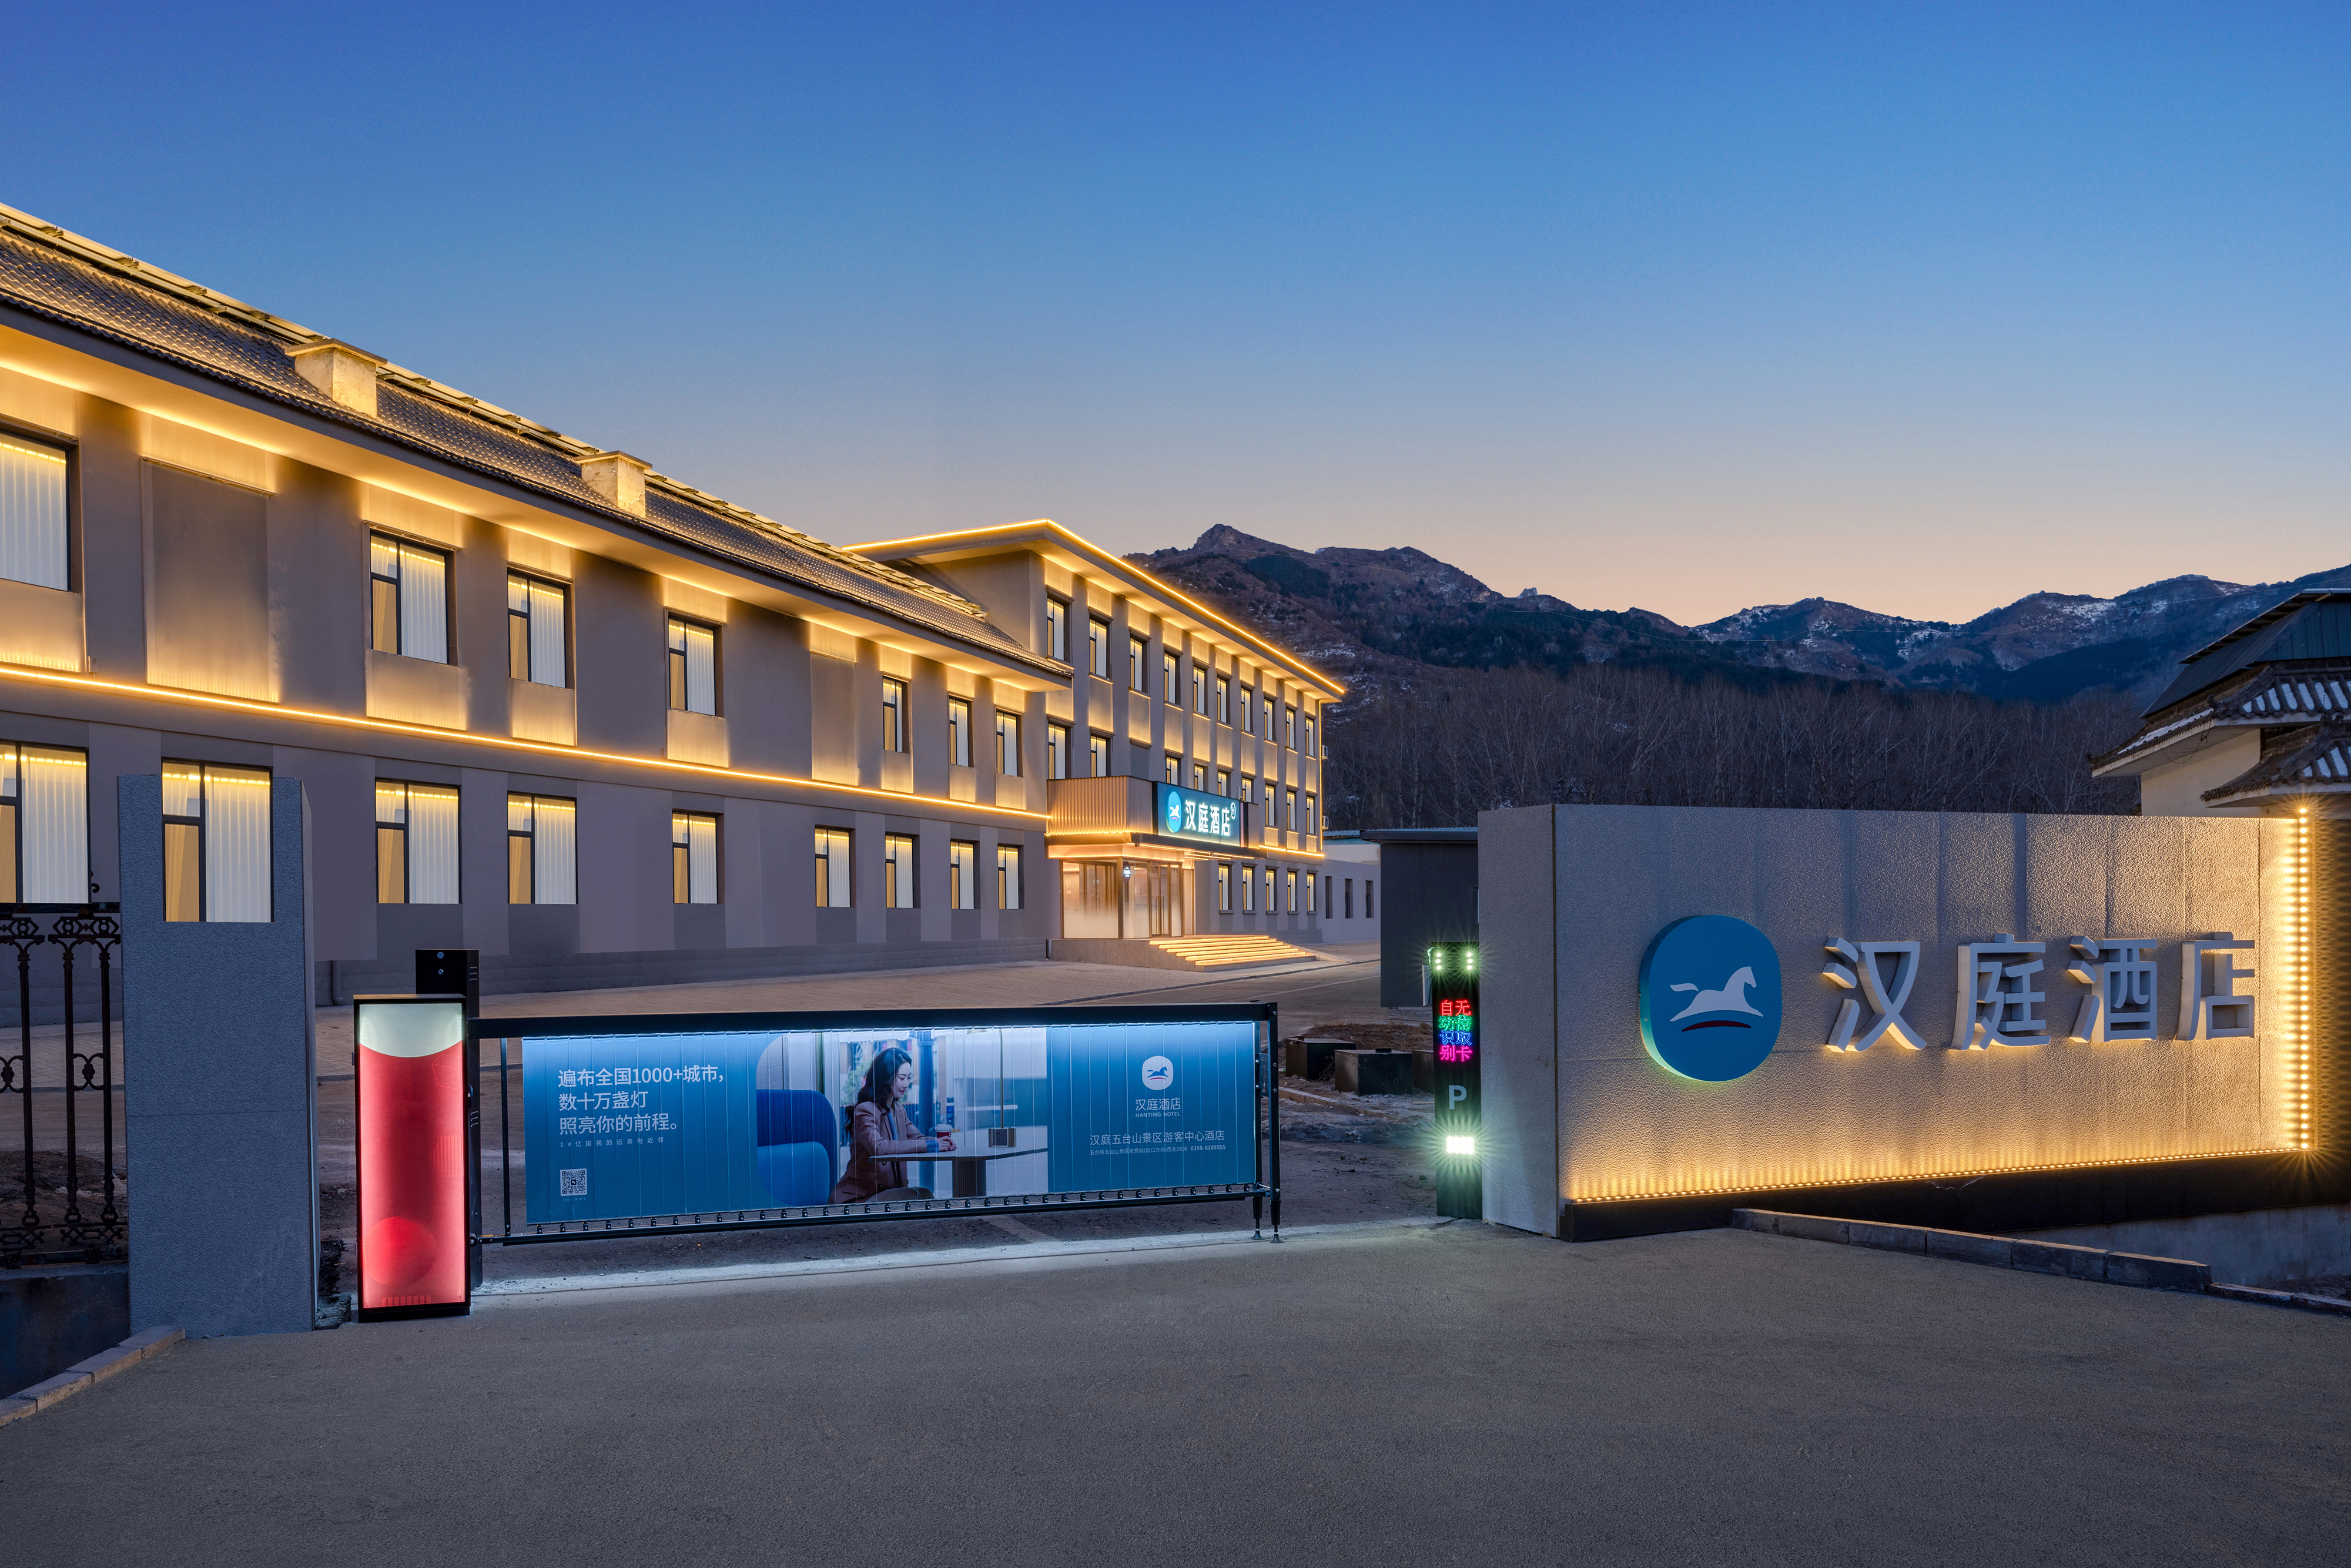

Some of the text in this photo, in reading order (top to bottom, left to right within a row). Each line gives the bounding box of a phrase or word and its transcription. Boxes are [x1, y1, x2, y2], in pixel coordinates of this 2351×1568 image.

[1184, 799, 1230, 837] 汉庭酒店
[1821, 931, 2256, 1053] 汉庭酒店
[558, 1064, 724, 1088] 遍布全国1000+城市，
[558, 1090, 649, 1112] 数十万盏灯
[1135, 1097, 1181, 1111] 汉庭酒店
[1448, 1085, 1467, 1110] P
[559, 1113, 677, 1135] 照亮你的前程。
[1089, 1130, 1225, 1145] 汉庭五台山景区游客中心酒店
